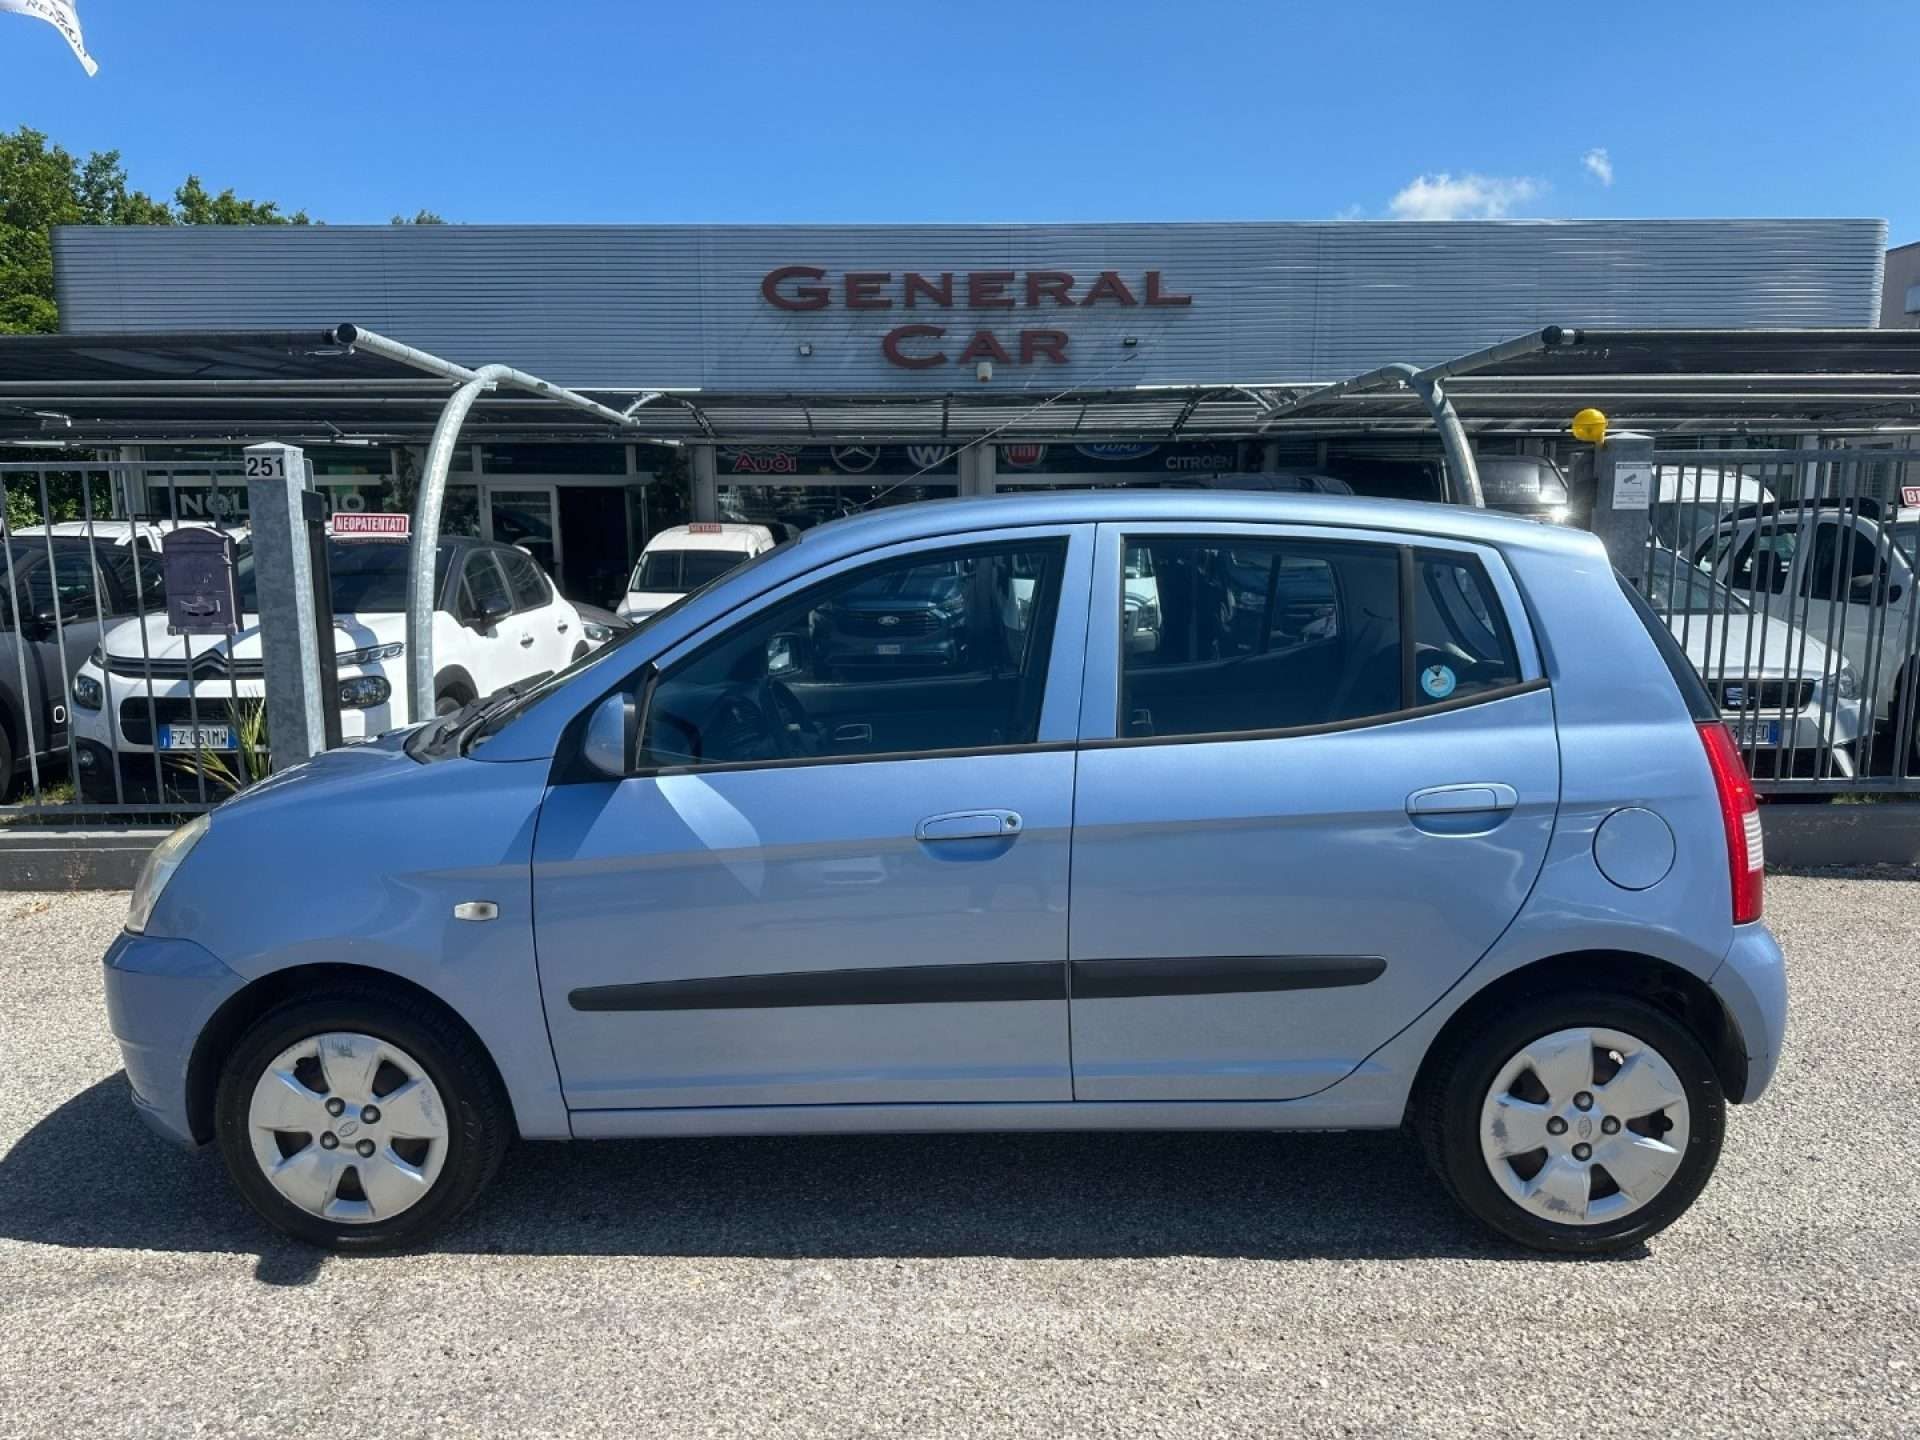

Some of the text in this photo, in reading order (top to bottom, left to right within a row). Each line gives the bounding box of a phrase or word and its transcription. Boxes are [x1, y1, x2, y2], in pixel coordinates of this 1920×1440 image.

[761, 266, 1192, 311] GENERAL
[882, 324, 1070, 369] CAR
[247, 457, 284, 477] 251
[733, 451, 797, 472] Audi
[335, 516, 406, 532] NEOPATENTATI
